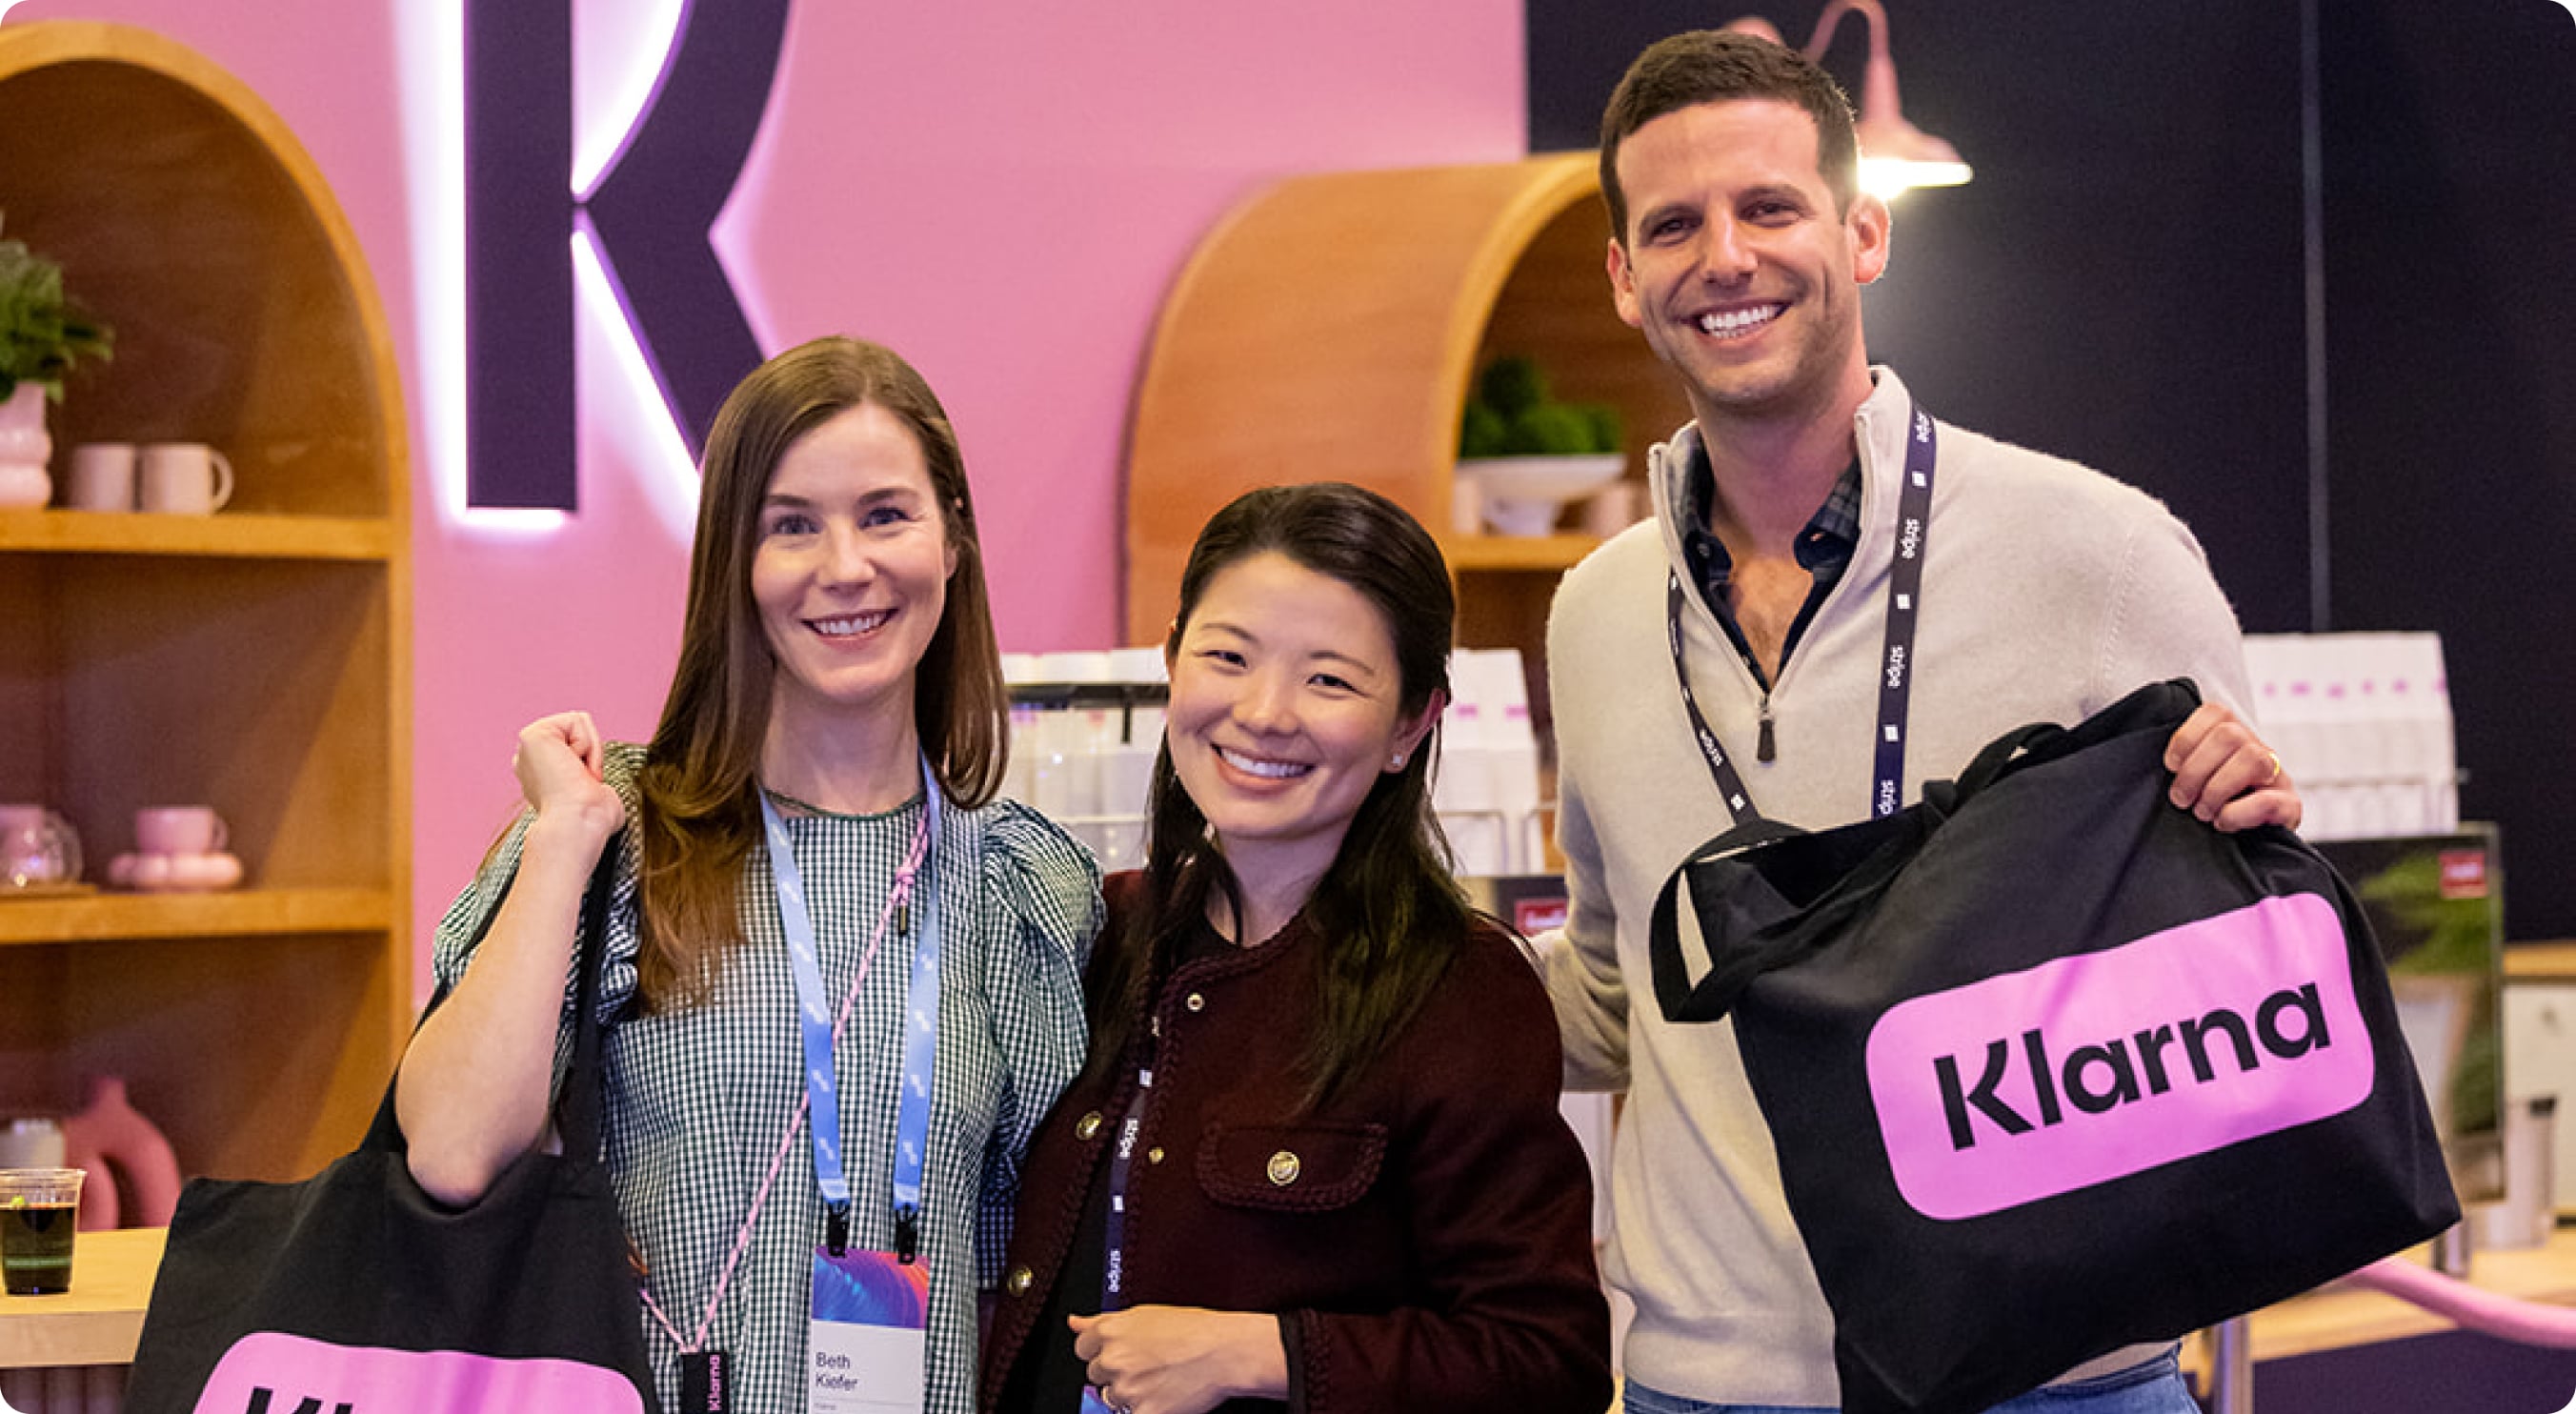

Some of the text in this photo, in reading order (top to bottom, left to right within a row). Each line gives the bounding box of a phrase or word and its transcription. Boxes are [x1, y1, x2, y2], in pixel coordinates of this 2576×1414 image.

[1900, 517, 1922, 559] stripe
[1885, 644, 1905, 689] stripe
[1878, 779, 1898, 815] strip
[1933, 982, 2331, 1151] Klarna
[1118, 1118, 1139, 1160] stripe
[1107, 1249, 1123, 1293] stripe
[815, 1351, 851, 1369] Beth
[707, 1354, 721, 1411] Klarna
